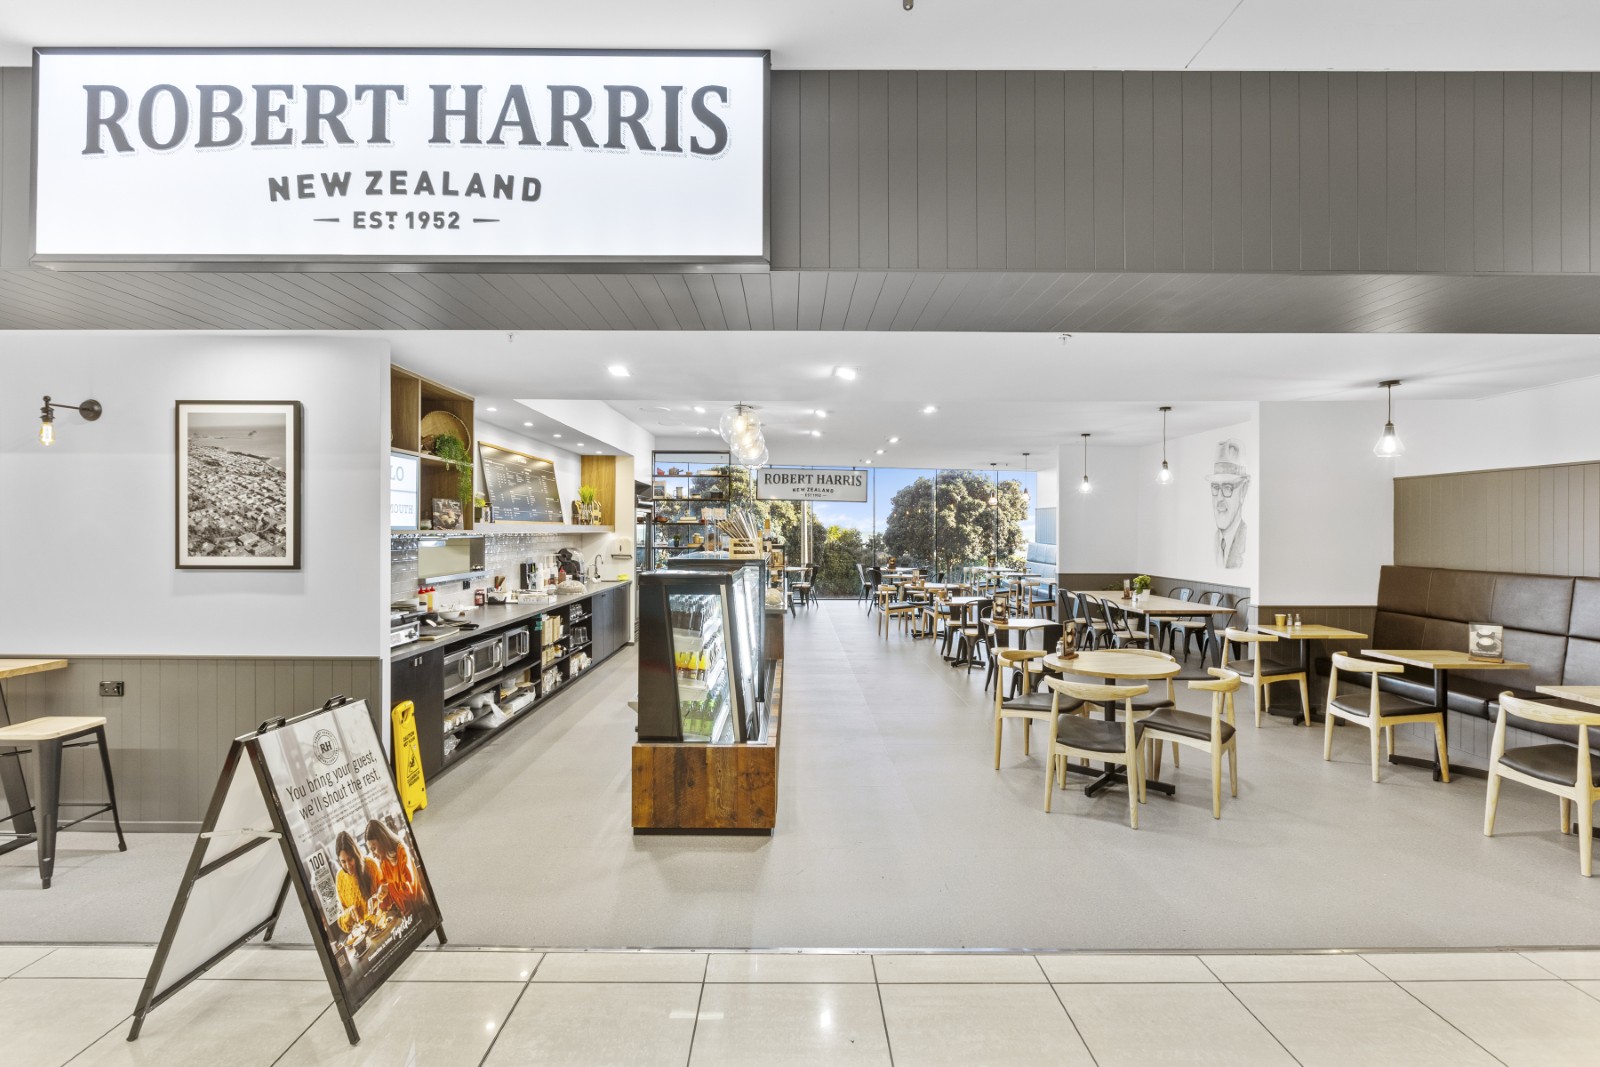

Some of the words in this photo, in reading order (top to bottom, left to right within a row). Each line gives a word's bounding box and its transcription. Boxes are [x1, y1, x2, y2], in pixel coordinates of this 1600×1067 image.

[82, 84, 407, 158] ROBERT
[428, 84, 731, 159] HARRIS
[268, 171, 351, 202] NEW
[365, 170, 542, 202] ZEALAND
[405, 211, 460, 230] 1952
[764, 473, 814, 485] ROBERT
[816, 474, 863, 487] HARRIS
[320, 740, 332, 754] RH
[286, 785, 307, 802] You
[306, 772, 334, 793] bring
[332, 762, 351, 783] your
[352, 749, 378, 774] guest,
[299, 796, 323, 820] we'll
[322, 784, 349, 808] shout
[347, 778, 362, 794] the
[362, 768, 381, 786] rest.
[309, 852, 325, 871] 100
